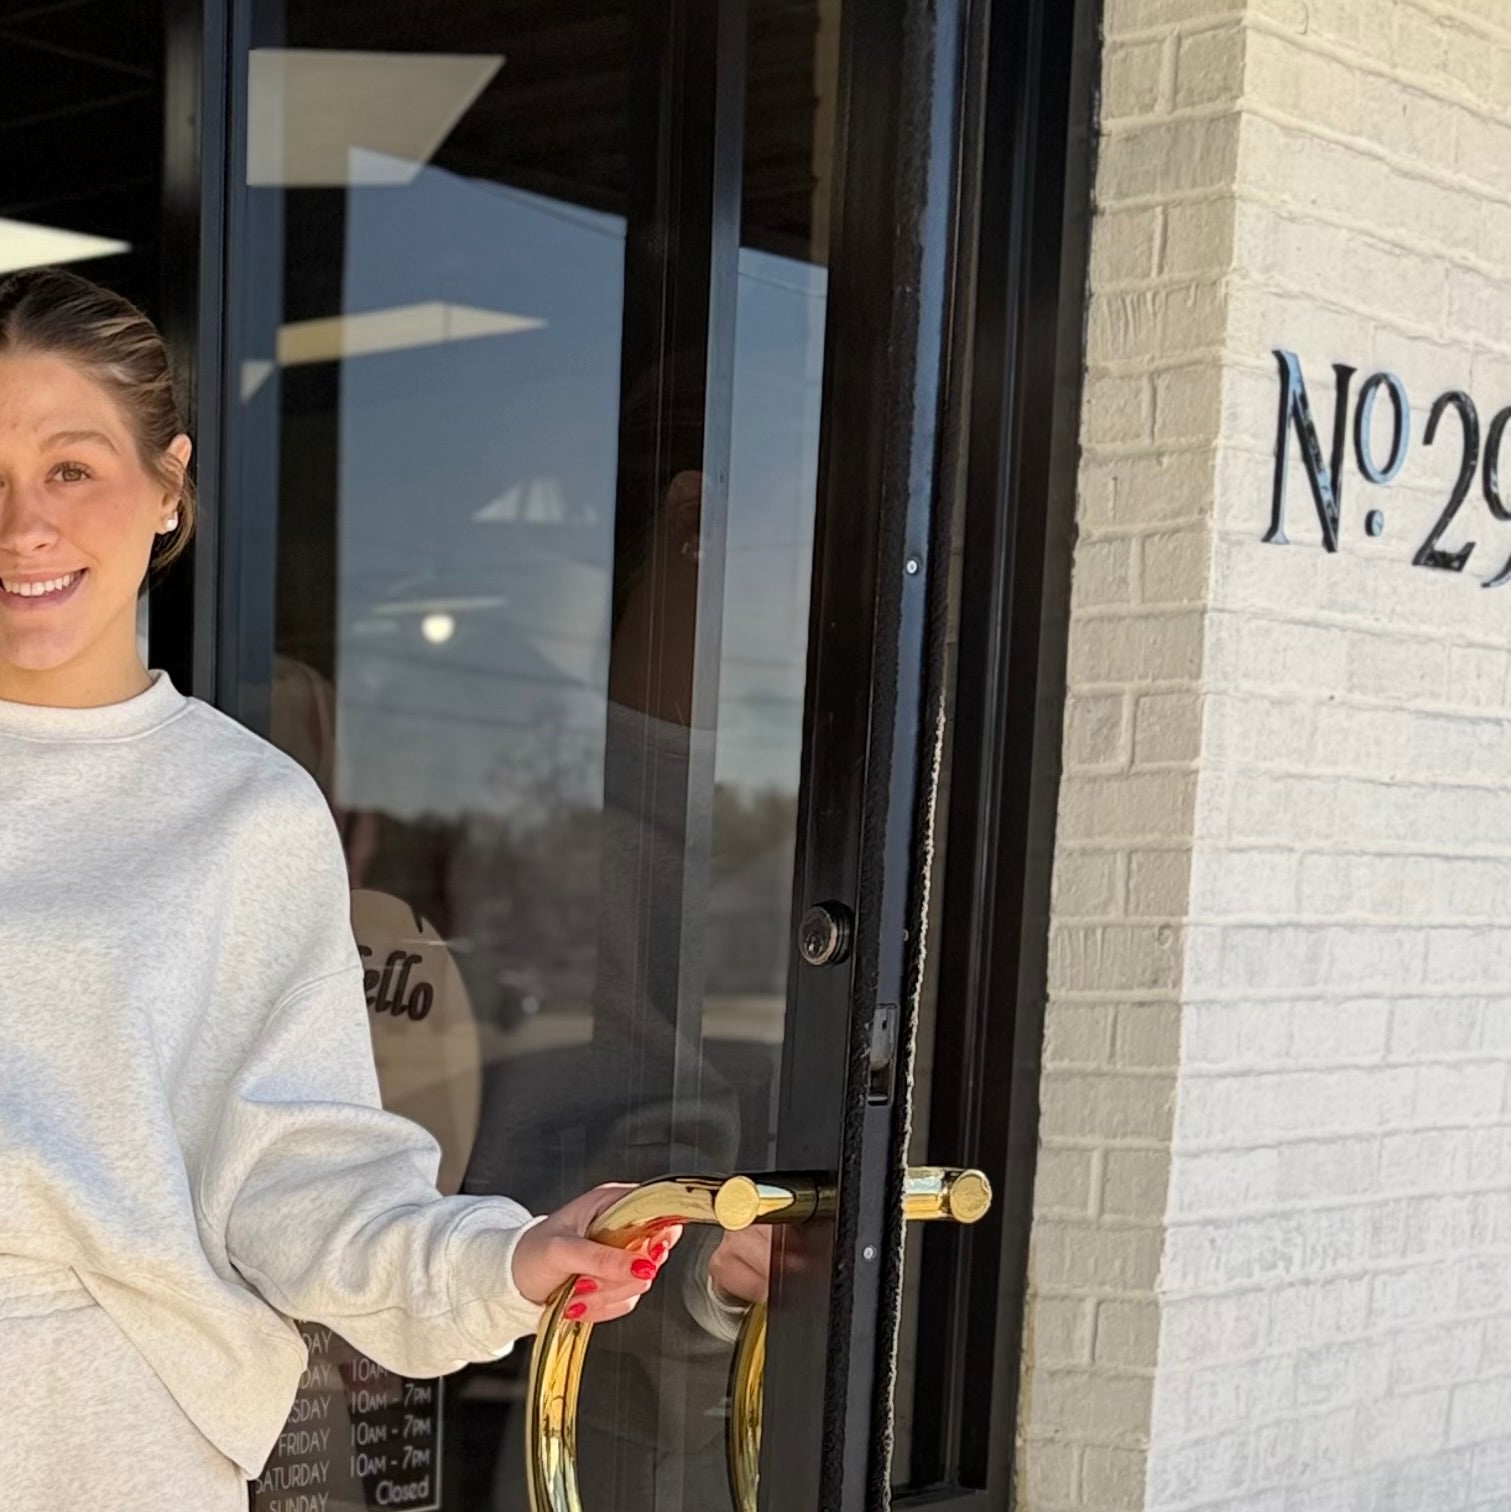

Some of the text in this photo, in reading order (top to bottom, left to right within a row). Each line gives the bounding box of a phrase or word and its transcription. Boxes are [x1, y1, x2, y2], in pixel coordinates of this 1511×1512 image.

[358, 945, 434, 1021] ello
[288, 1395, 332, 1425] SDAY
[351, 1389, 388, 1415] 10AM
[403, 1383, 432, 1407] 7PM
[277, 1427, 331, 1458] FRIDAY
[350, 1421, 387, 1447] 10AM
[402, 1415, 432, 1439] 7PM
[255, 1460, 330, 1494] SATURDAY
[349, 1453, 387, 1478] 10AM
[402, 1446, 431, 1471] 7PM
[375, 1474, 430, 1505] Closed
